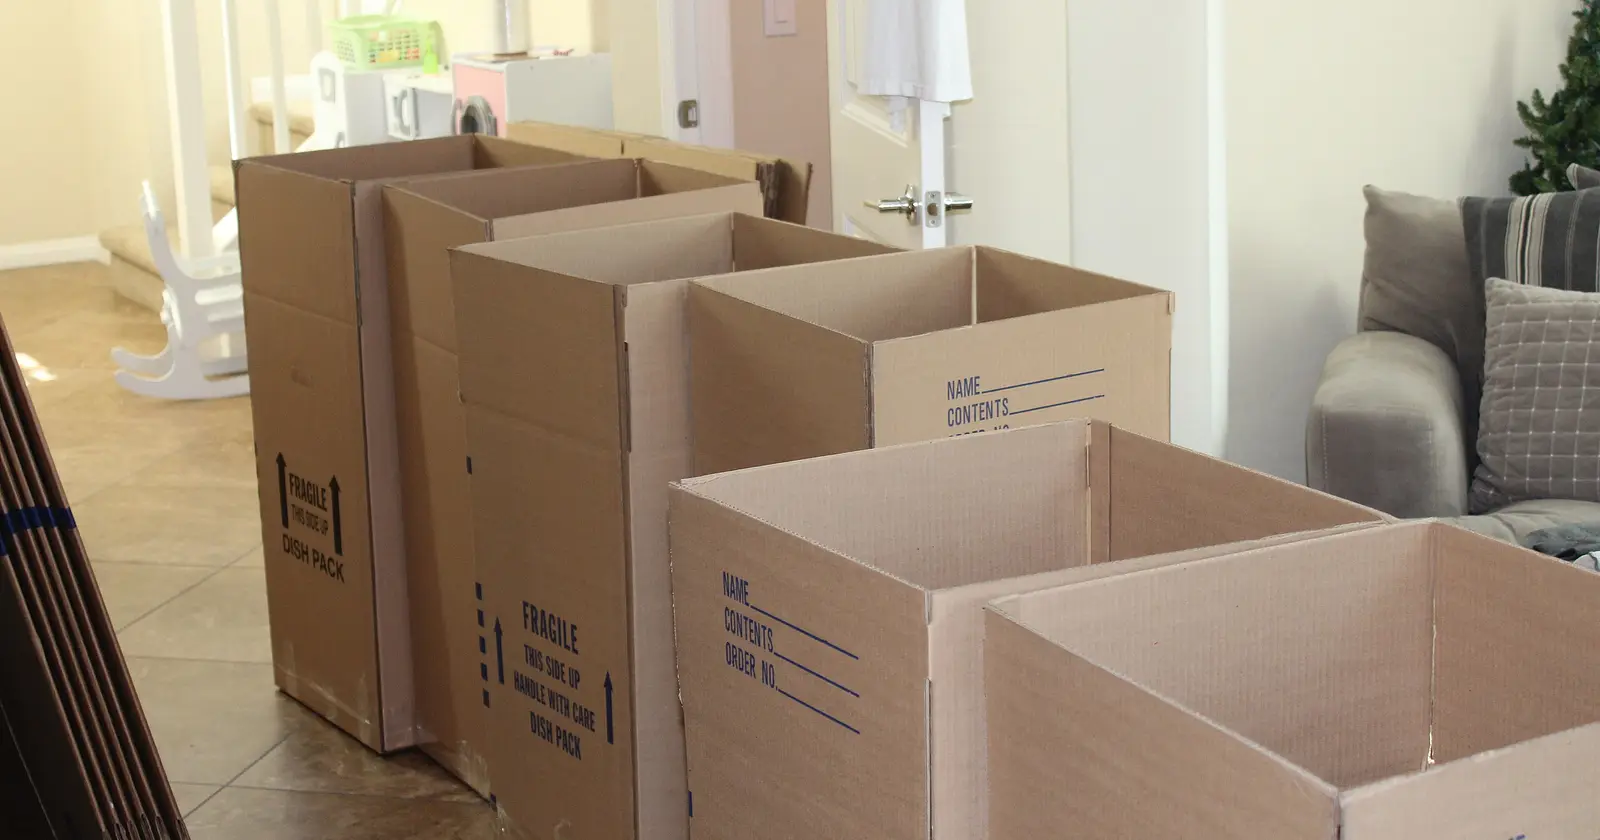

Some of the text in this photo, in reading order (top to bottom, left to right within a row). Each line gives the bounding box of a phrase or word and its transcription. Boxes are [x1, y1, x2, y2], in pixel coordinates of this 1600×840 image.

[947, 376, 981, 400] NAME
[947, 398, 1009, 427] CONTENTS
[288, 472, 327, 512] FRAGILE
[291, 503, 305, 526] THIS
[282, 534, 345, 583] DISH PACK
[723, 571, 750, 606] NAME
[522, 600, 579, 655] FRAGILE
[724, 606, 774, 653] CONTENTS
[523, 643, 581, 690] THIS SIDE UP
[725, 641, 757, 679] ORDER
[513, 669, 596, 733] HANDLE WITH CARE
[530, 710, 582, 761] DISH PACK
